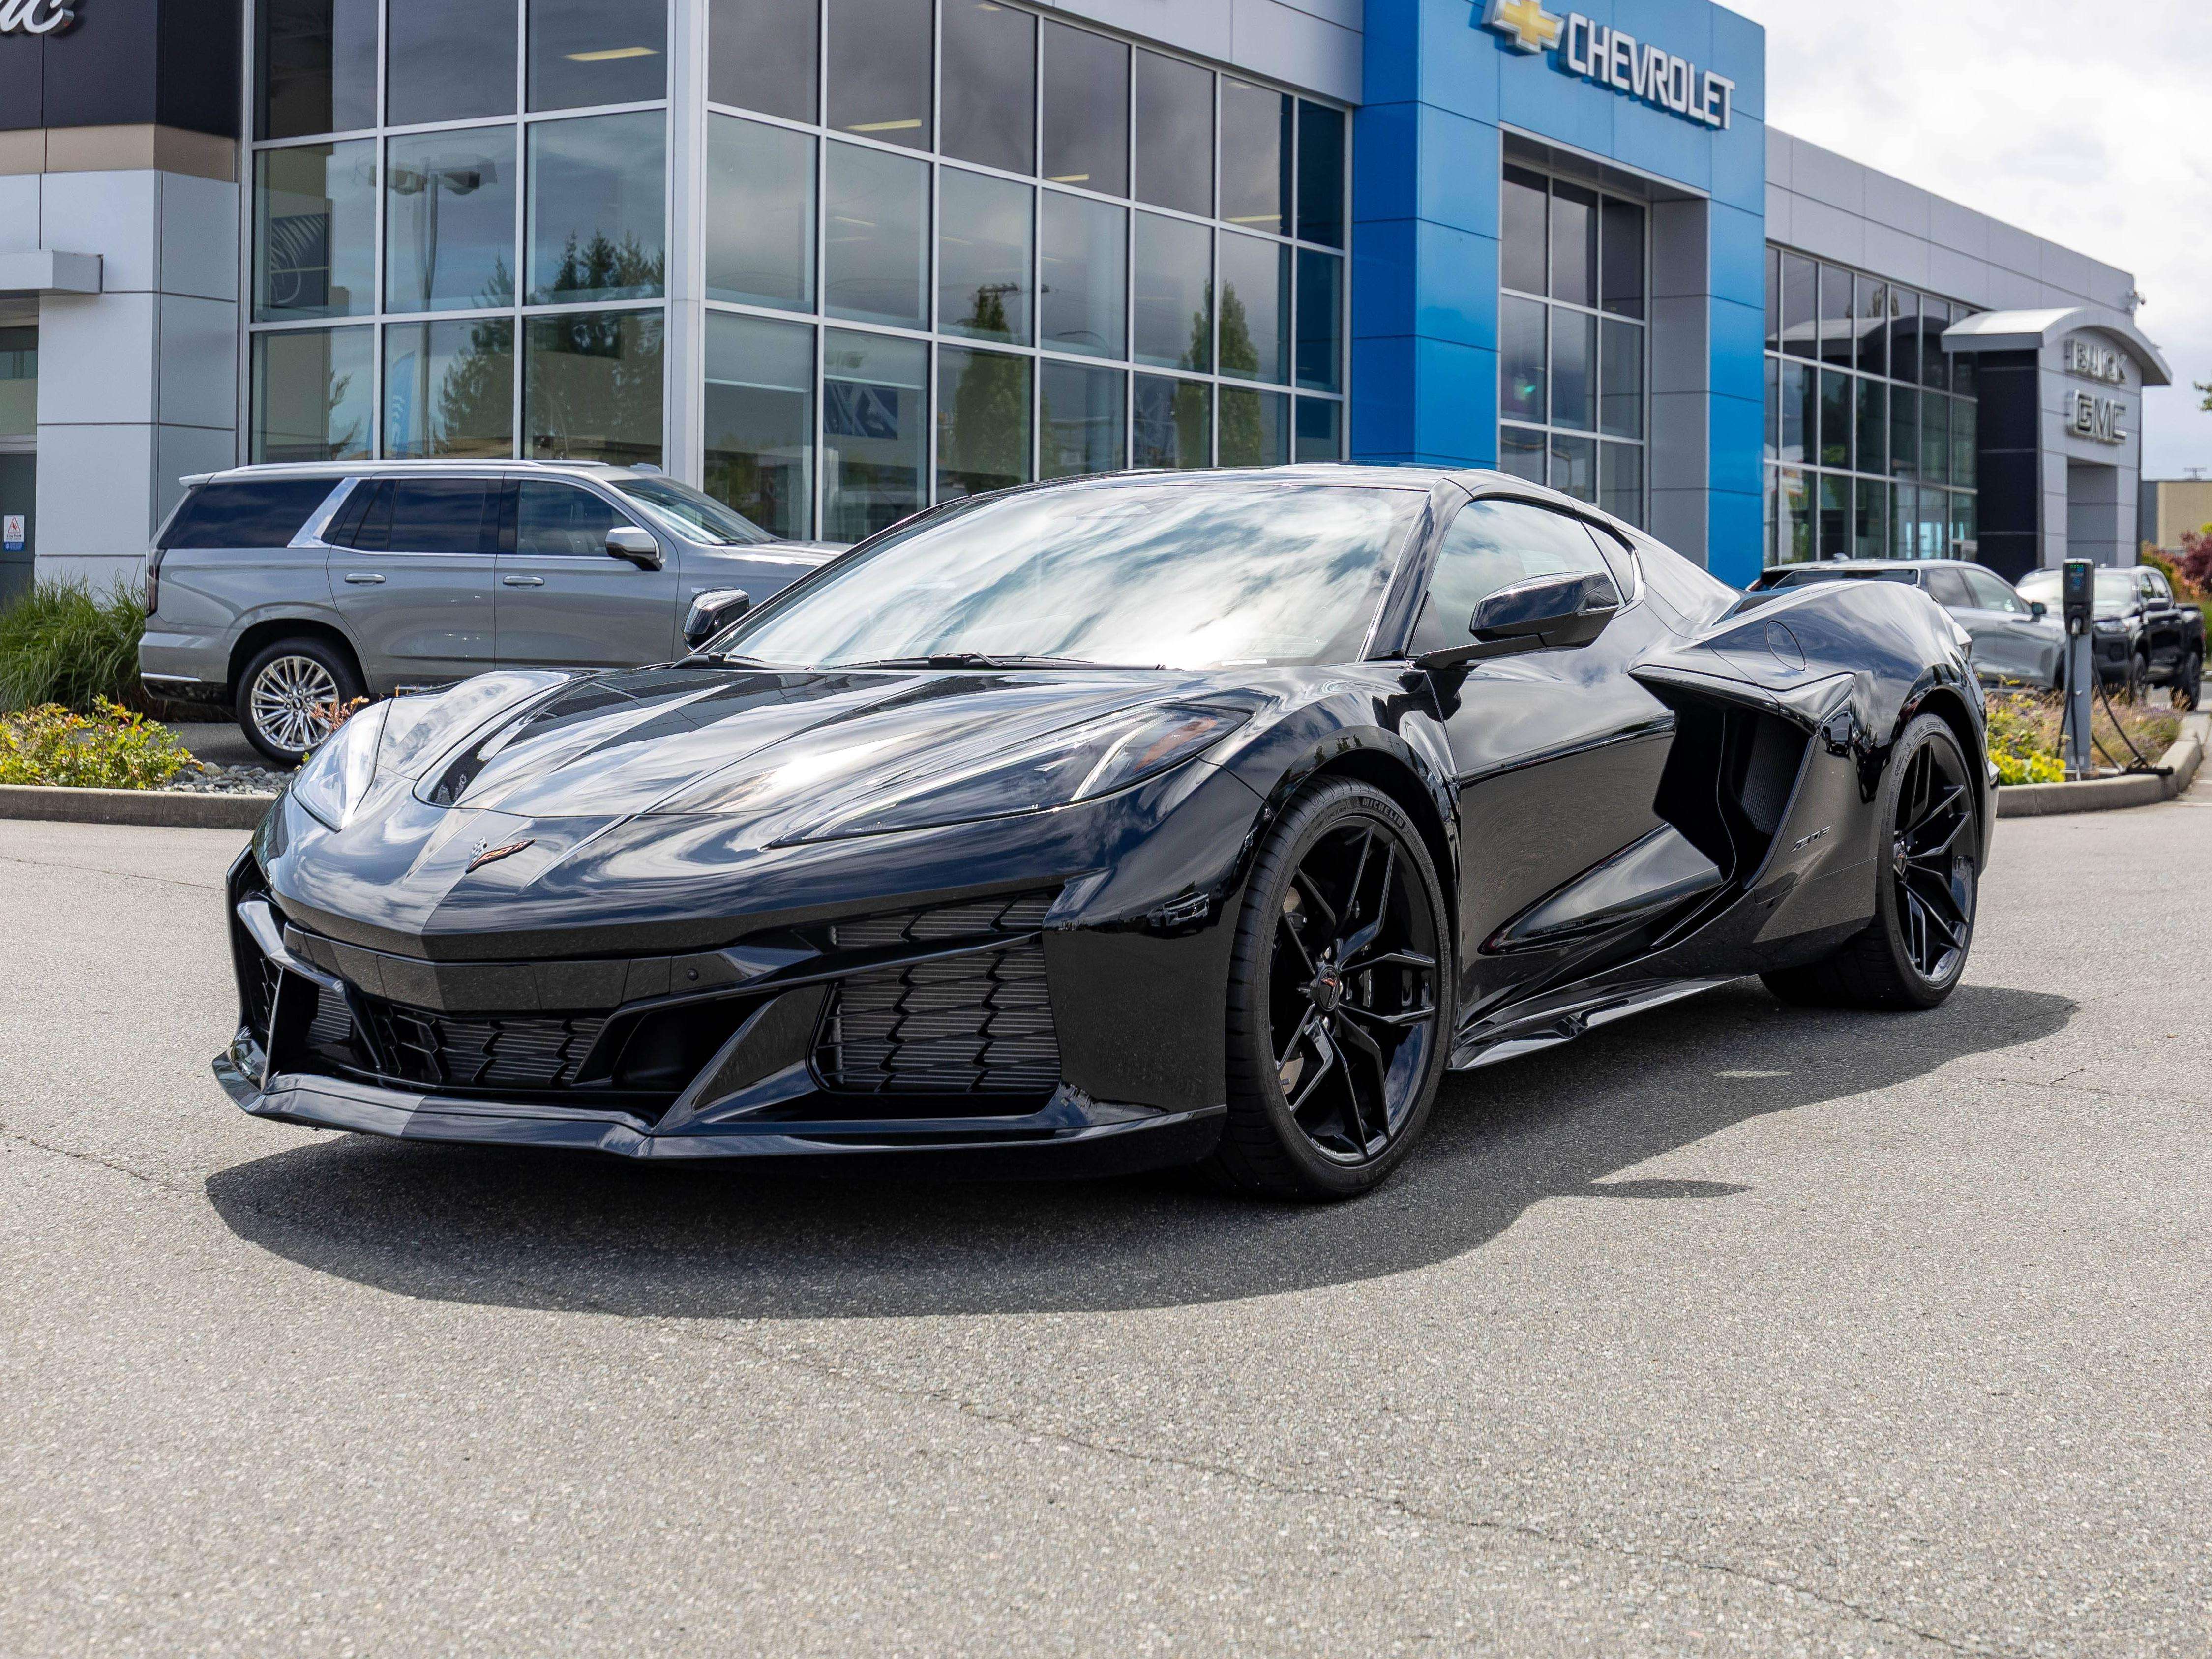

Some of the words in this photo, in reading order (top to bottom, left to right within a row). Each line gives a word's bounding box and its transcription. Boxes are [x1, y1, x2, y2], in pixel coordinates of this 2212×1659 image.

[1567, 12, 1736, 129] CHEVROLET
[2073, 338, 2128, 382] BUICK
[2072, 388, 2128, 441] GMC
[1362, 798, 1404, 827] MICHELIN
